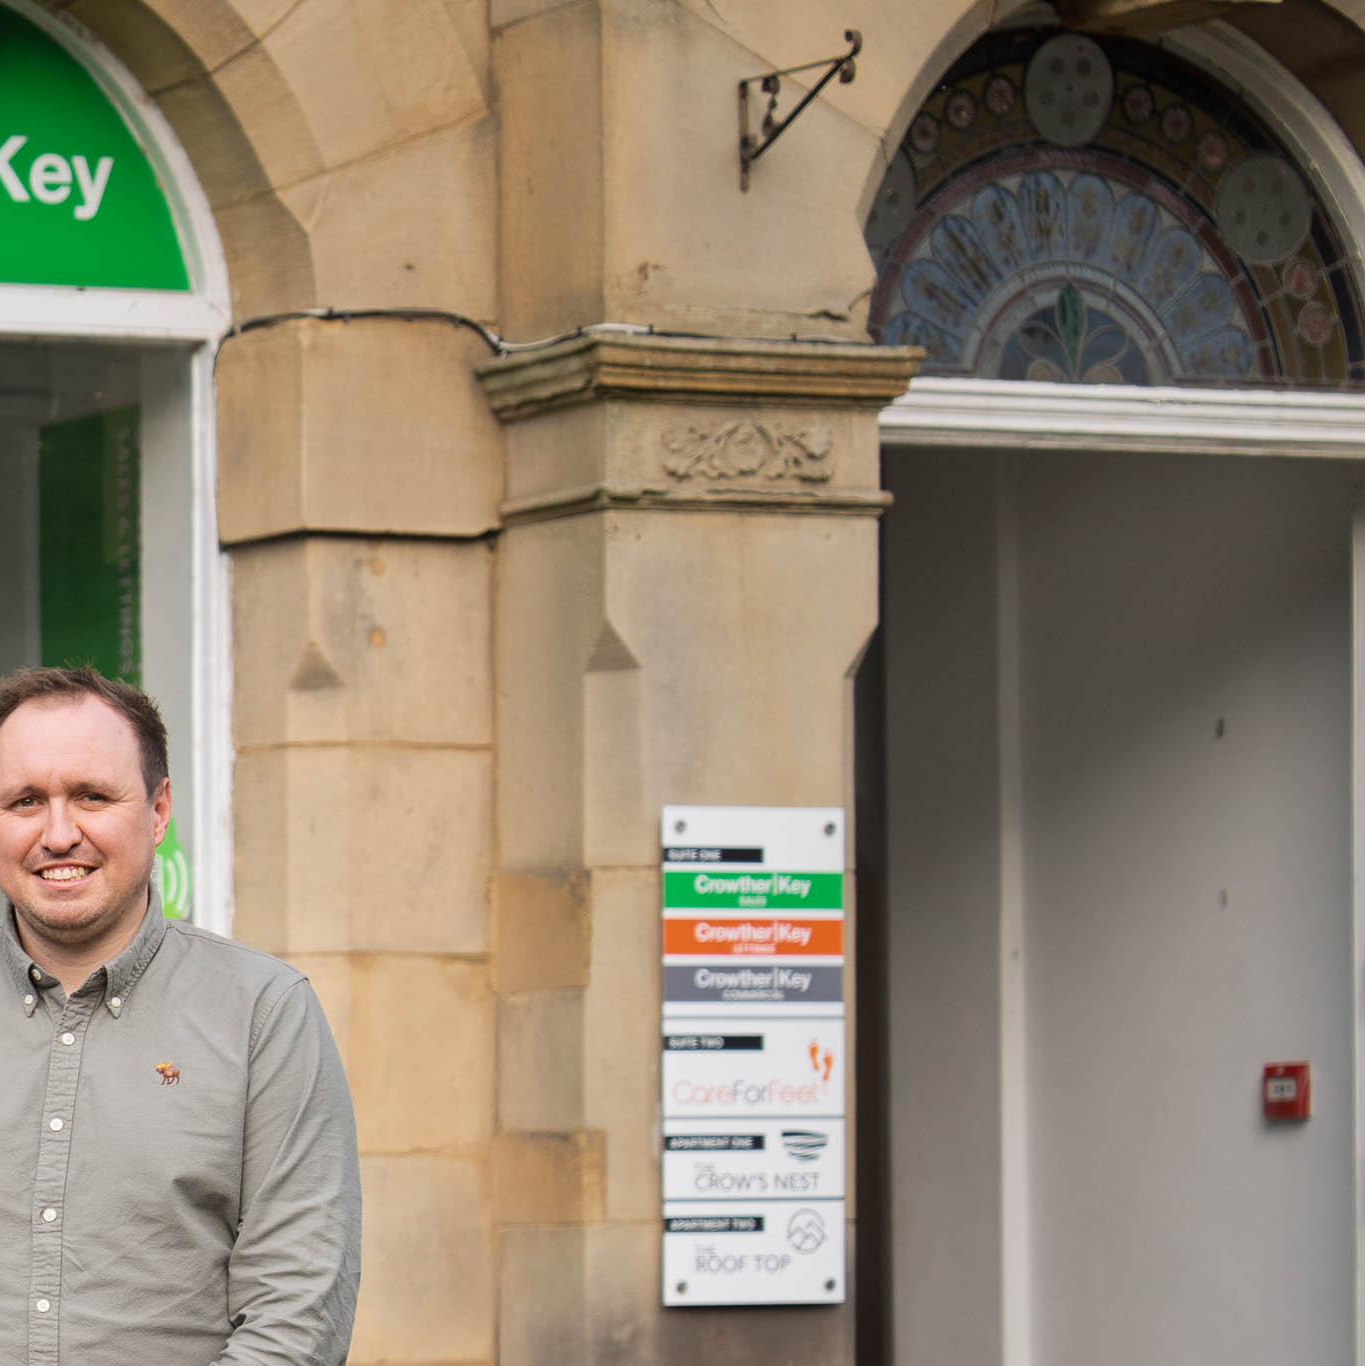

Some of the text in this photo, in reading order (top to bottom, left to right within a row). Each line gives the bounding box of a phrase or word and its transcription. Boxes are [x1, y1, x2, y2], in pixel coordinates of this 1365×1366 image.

[694, 1172, 820, 1192] CROW'S NEST
[695, 1254, 791, 1273] ROOF TOP
